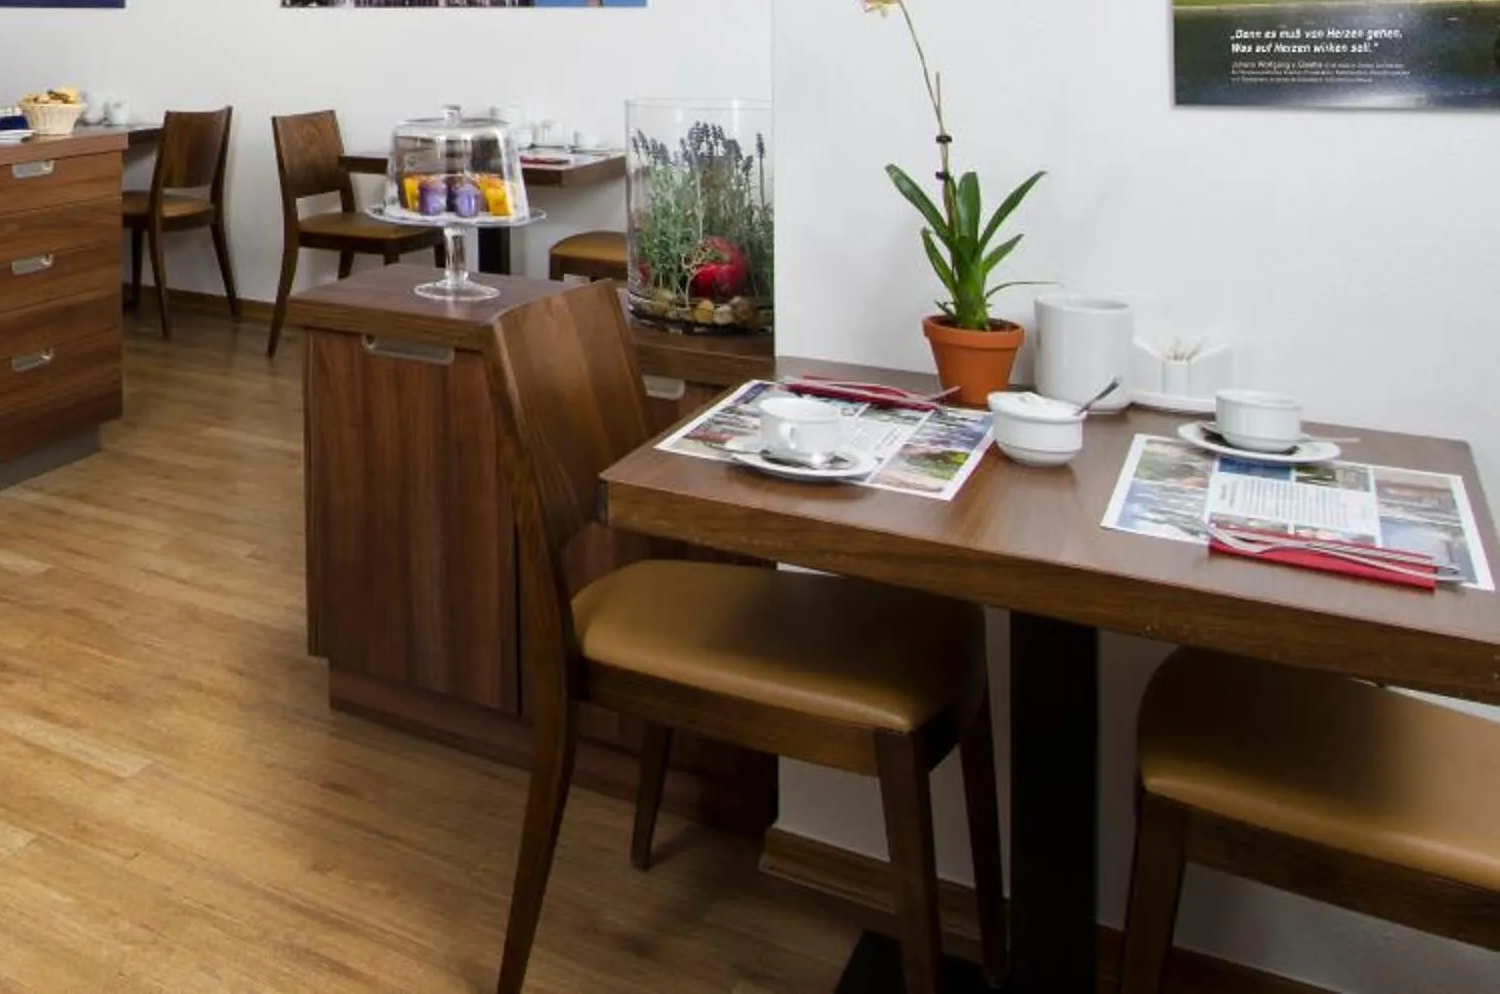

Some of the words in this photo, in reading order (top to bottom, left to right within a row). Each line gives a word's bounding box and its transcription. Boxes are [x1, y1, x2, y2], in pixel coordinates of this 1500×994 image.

[1326, 28, 1364, 39] Herzen
[1231, 42, 1253, 53] Was
[1255, 42, 1272, 53] auf
[1273, 42, 1311, 53] Herzen
[1313, 42, 1348, 53] wirken
